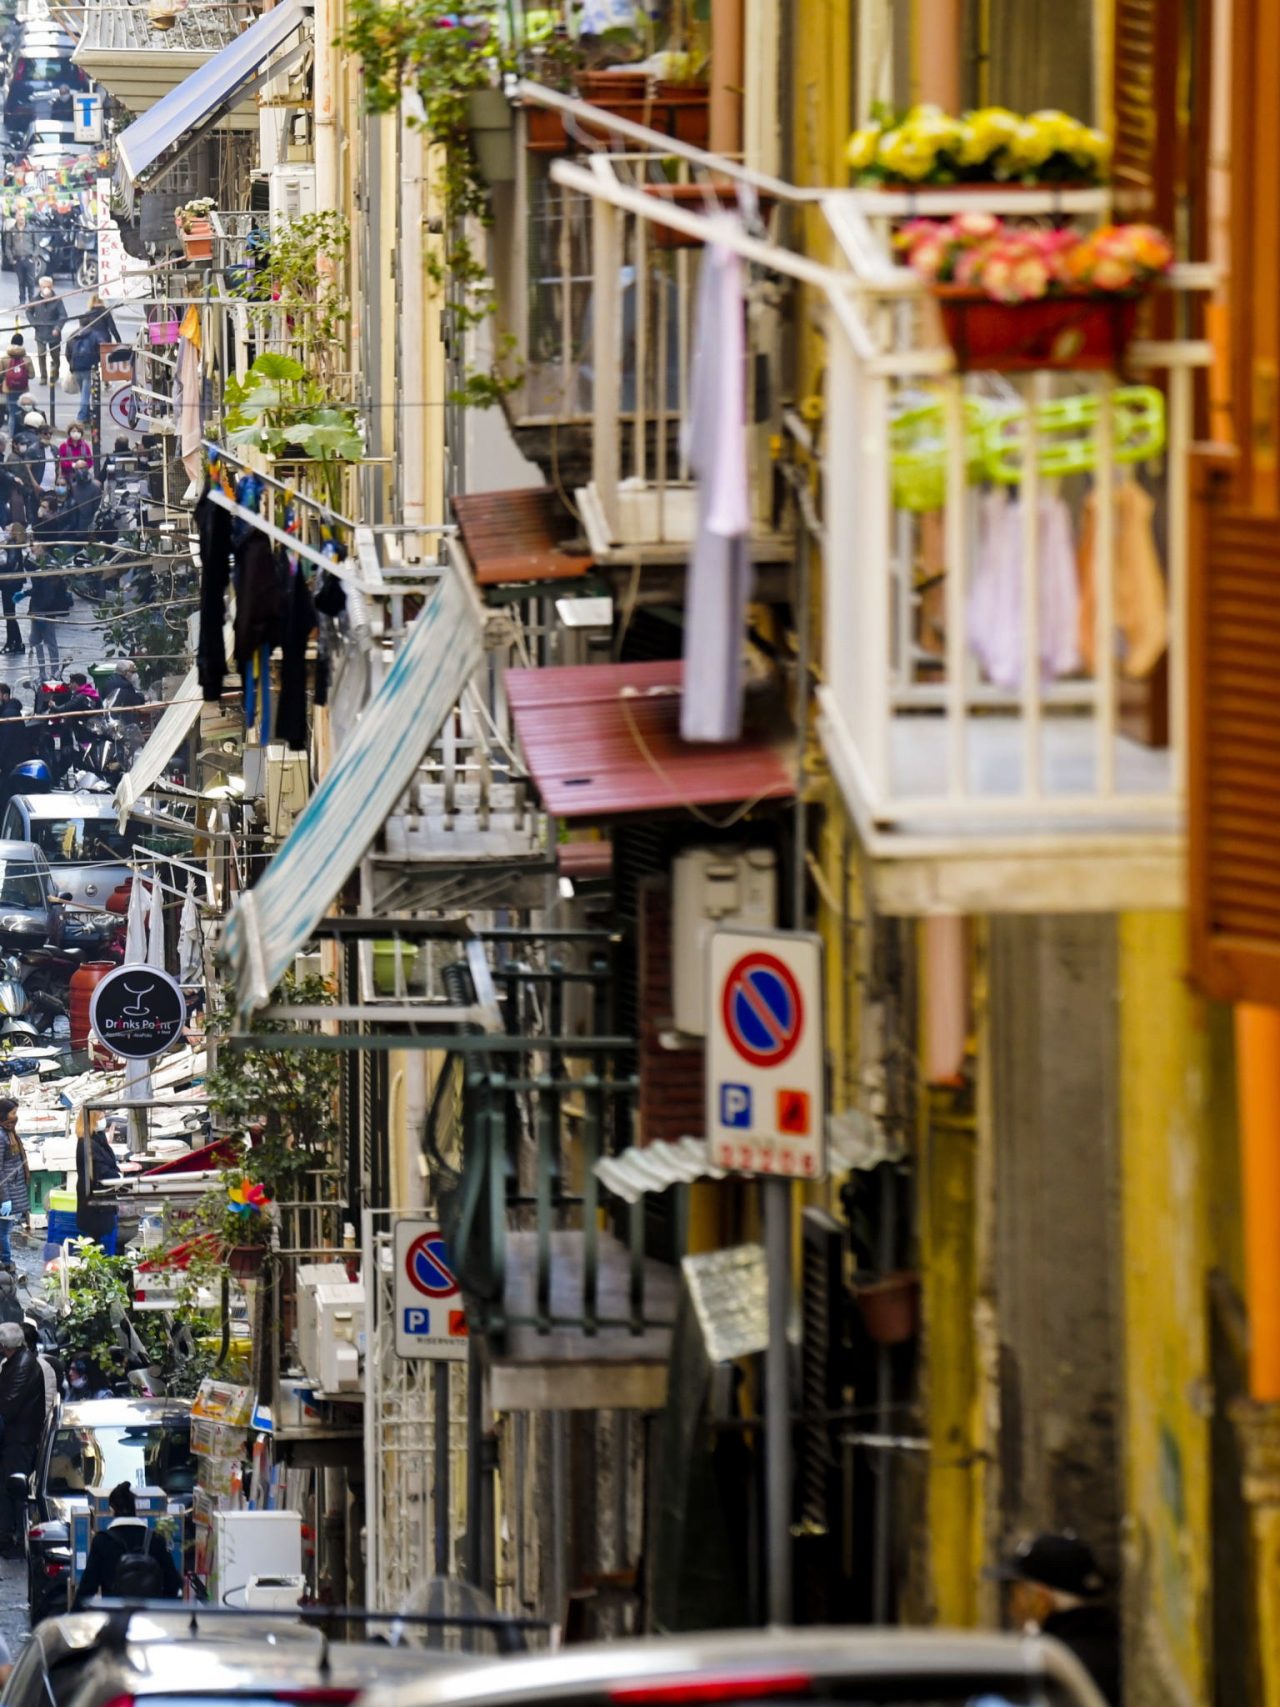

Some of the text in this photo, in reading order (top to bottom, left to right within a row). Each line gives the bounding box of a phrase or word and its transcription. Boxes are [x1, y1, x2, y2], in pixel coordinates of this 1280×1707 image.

[77, 98, 97, 127] T
[101, 194, 110, 296] PIZZERIA
[105, 1015, 140, 1030] Drinks
[726, 1088, 747, 1123] P
[409, 1311, 425, 1331] P
